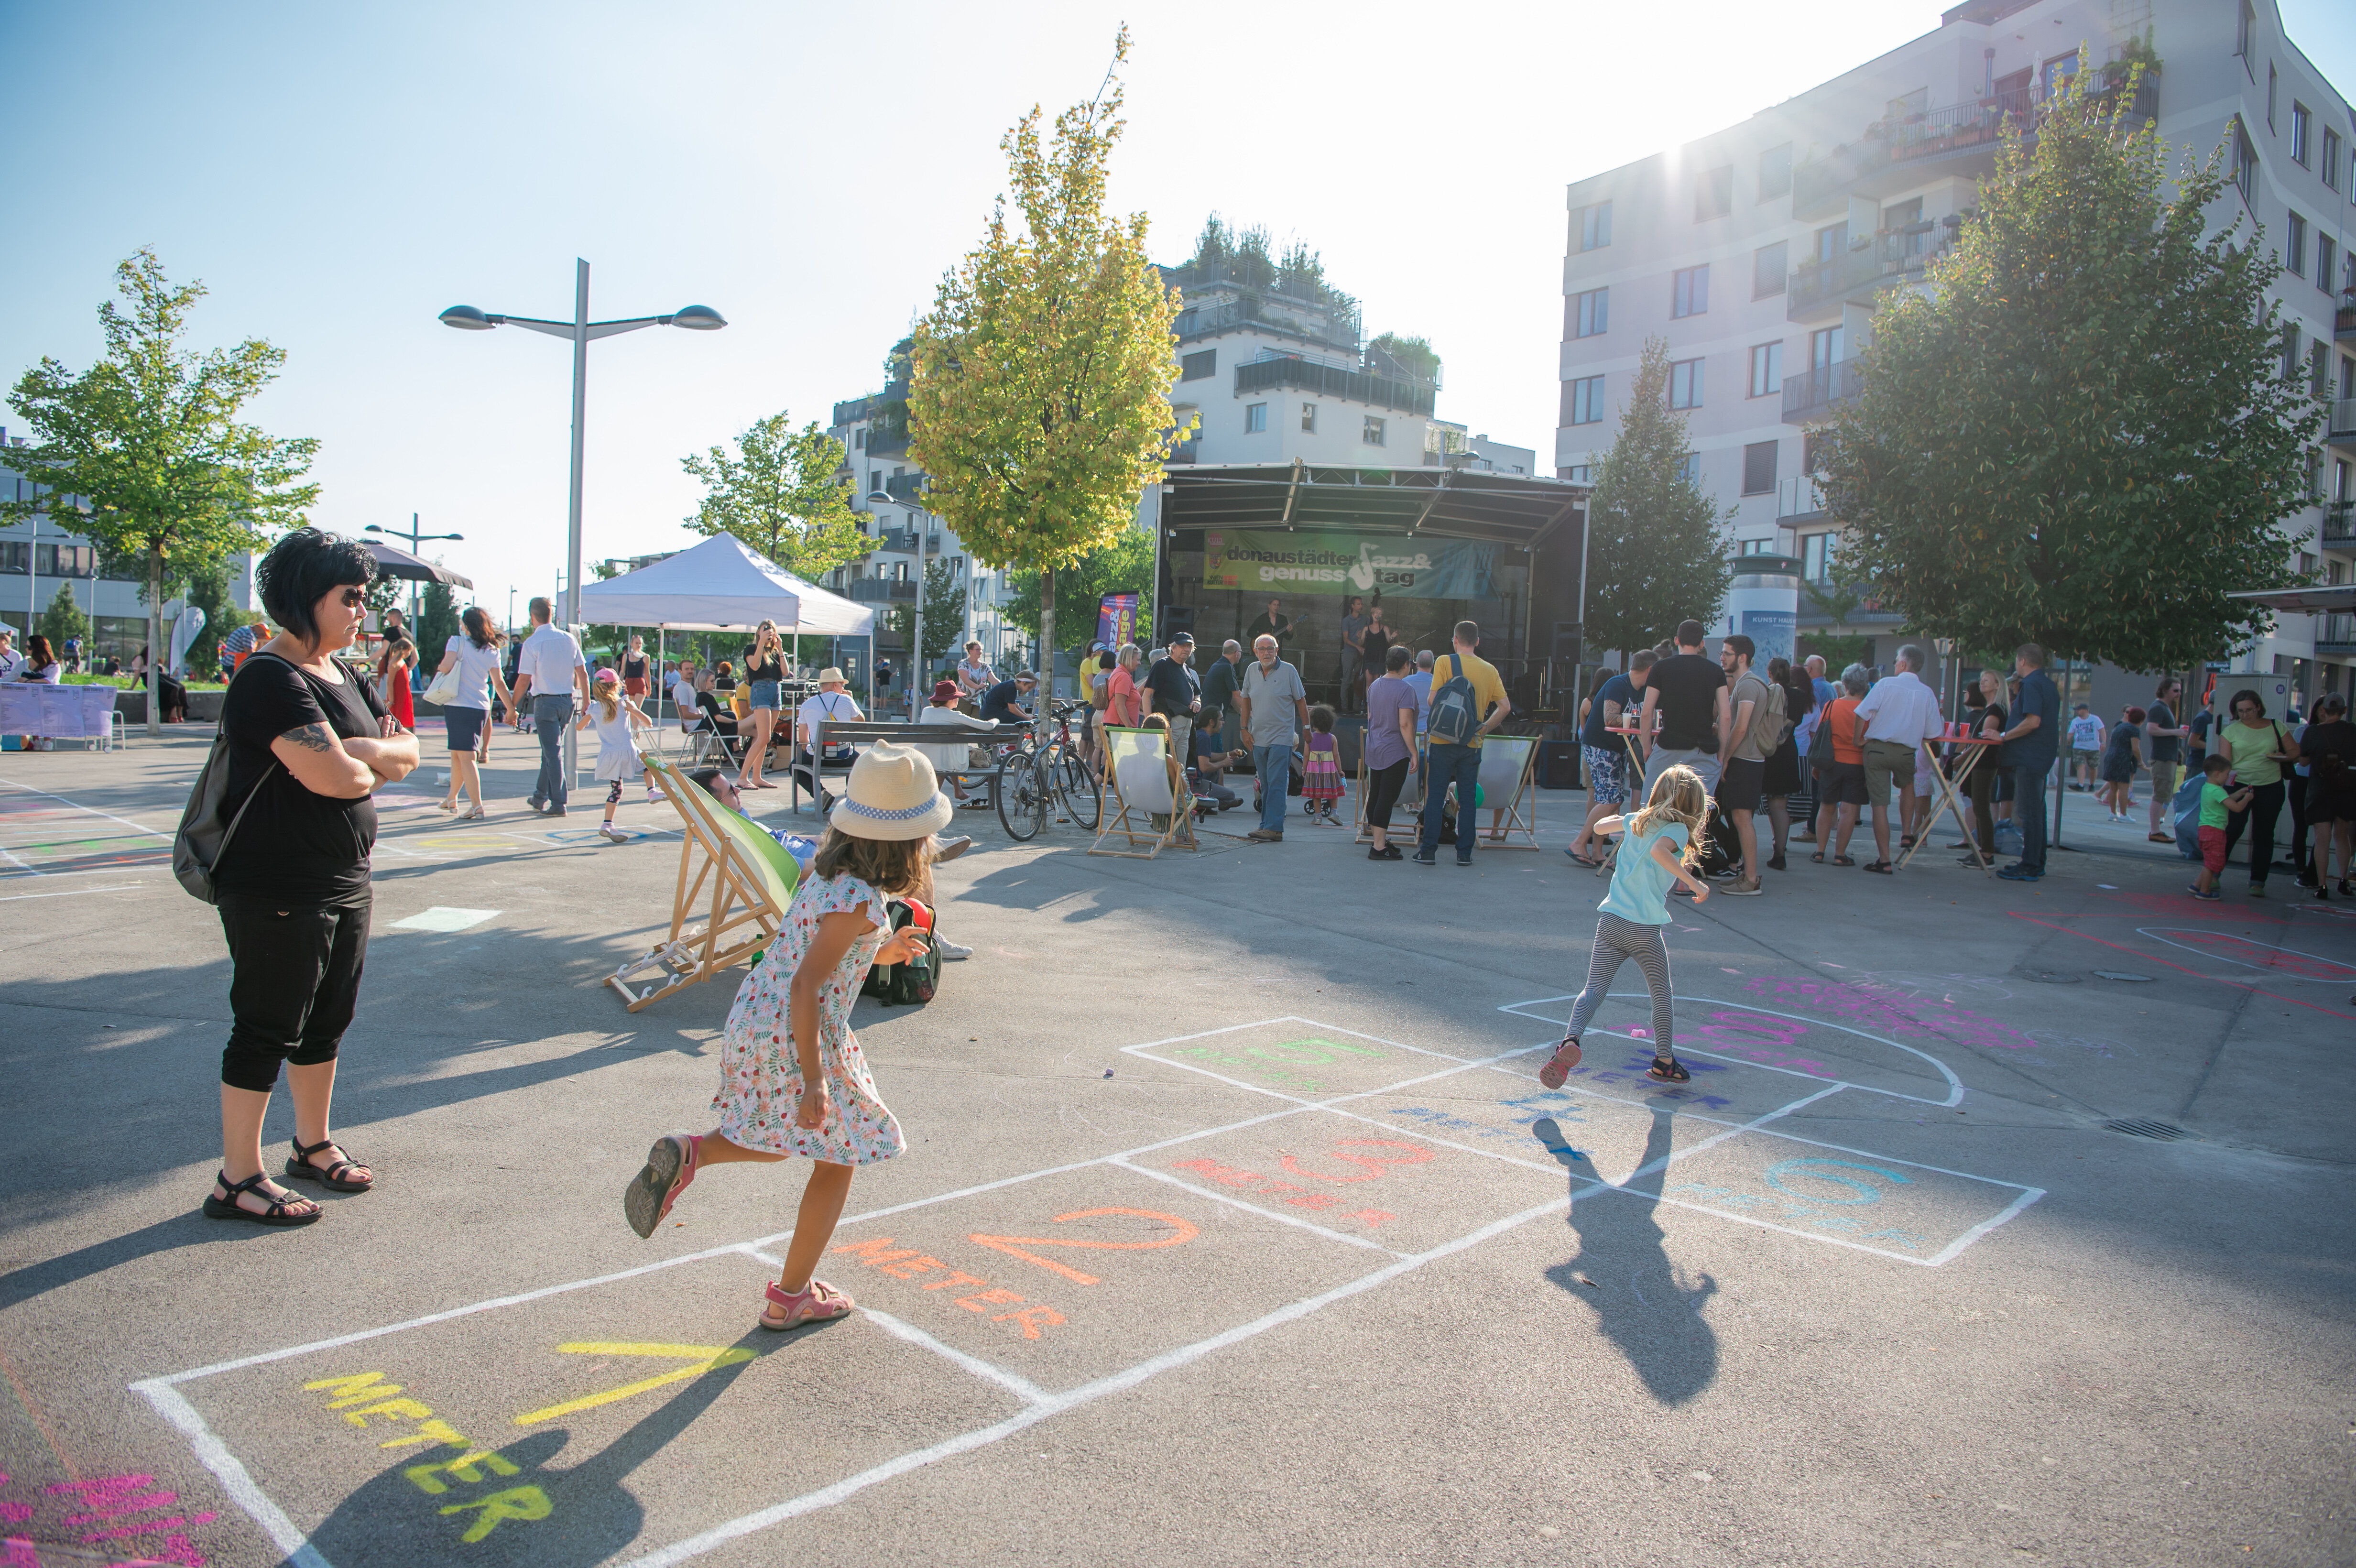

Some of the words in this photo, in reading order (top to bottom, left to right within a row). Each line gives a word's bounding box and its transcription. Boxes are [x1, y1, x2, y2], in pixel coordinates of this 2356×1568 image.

[1227, 545, 1357, 566] donaustädter
[1259, 566, 1347, 582] genuss
[1374, 569, 1415, 588] tag
[1435, 568, 1492, 594] FREI
[1699, 1011, 1808, 1045] 8
[1246, 1038, 1388, 1065] 5
[1280, 1139, 1436, 1183] 3
[1764, 1158, 1913, 1205] 6
[1173, 1158, 1396, 1229] METER
[968, 1207, 1200, 1286] 2
[832, 1237, 1066, 1339] METER
[515, 1341, 758, 1426] 1
[304, 1372, 553, 1543] METER
